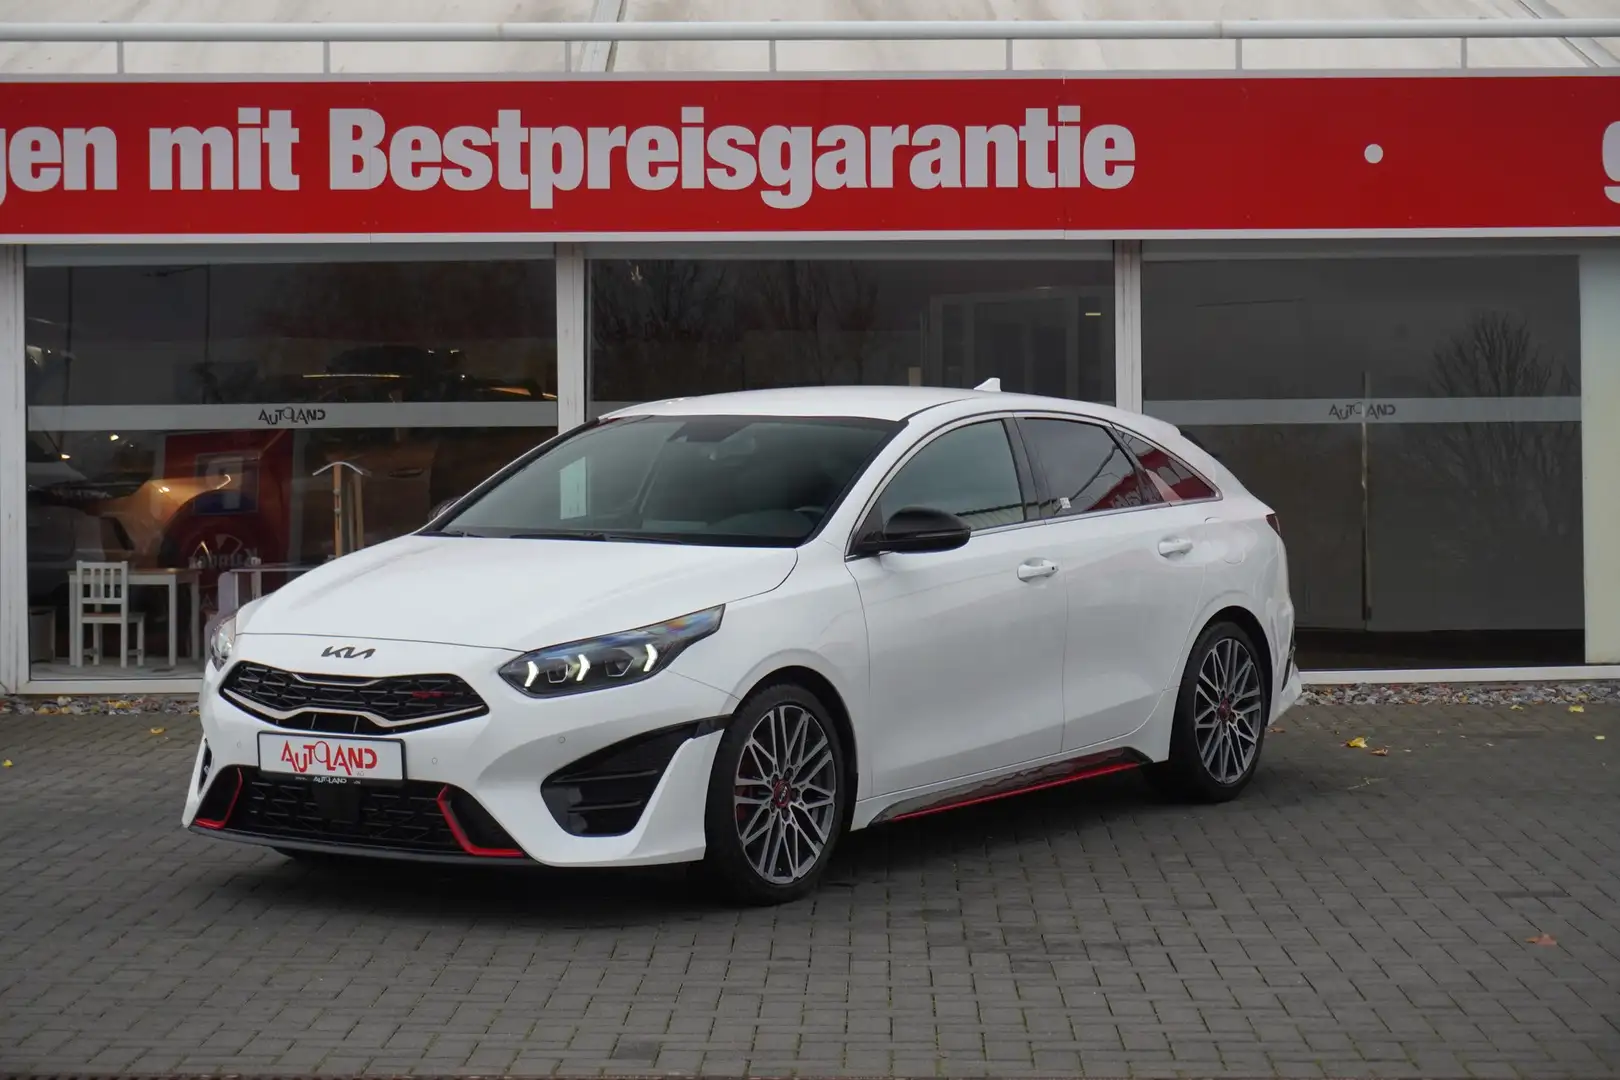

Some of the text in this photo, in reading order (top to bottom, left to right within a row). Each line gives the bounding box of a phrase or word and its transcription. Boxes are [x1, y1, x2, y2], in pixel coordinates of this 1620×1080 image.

[0, 105, 1136, 210] en mit Bestpreisgarantie
[258, 406, 326, 425] AUTOLAND
[1328, 401, 1396, 420] AUTOAND
[321, 646, 376, 660] KIA
[281, 740, 378, 776] AUTOLAND
